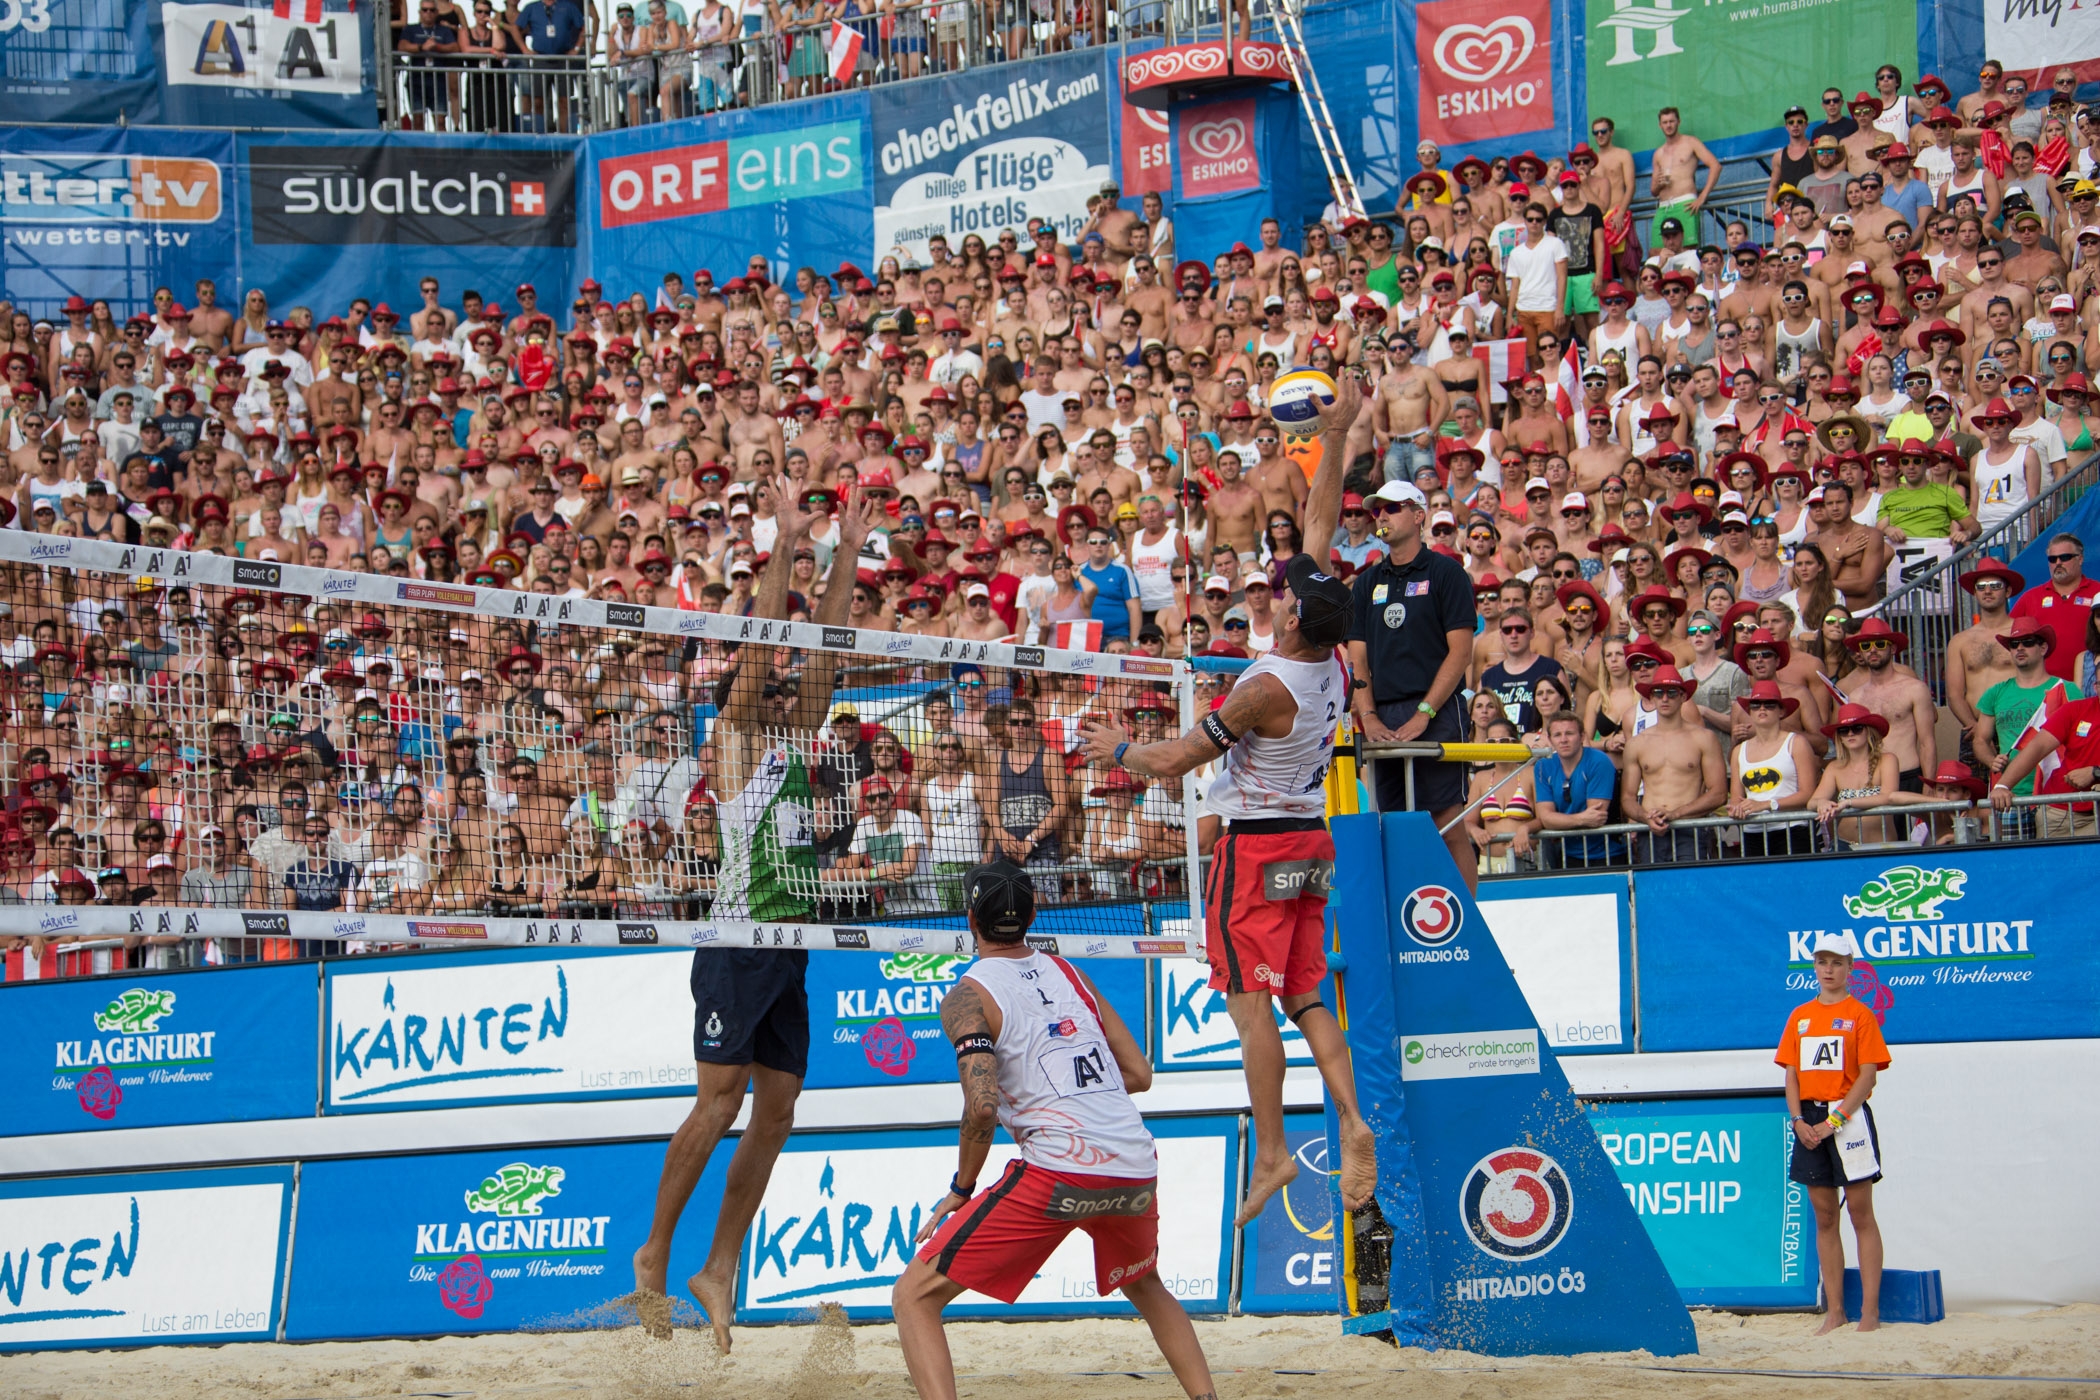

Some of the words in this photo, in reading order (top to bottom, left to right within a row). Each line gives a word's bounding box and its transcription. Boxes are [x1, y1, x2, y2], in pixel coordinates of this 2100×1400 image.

[1437, 81, 1536, 120] ESKIMO
[881, 72, 1100, 176] checkfelix.com
[609, 156, 720, 213] ORF
[735, 135, 852, 193] eins
[924, 176, 967, 201] billige
[974, 150, 1054, 193] Flüge
[1191, 157, 1249, 181] ESKIMO
[0, 171, 209, 207] tter.tv
[283, 171, 506, 216] swatch
[950, 196, 1027, 235] Hotels
[237, 566, 266, 581] smart
[608, 608, 633, 622] smart
[825, 631, 845, 644] smart
[1017, 650, 1036, 663] smart
[1320, 676, 1331, 694] AUT
[1326, 701, 1337, 723] 2
[247, 917, 277, 930] smart
[622, 928, 646, 940] smart
[837, 932, 858, 943] smart
[1028, 940, 1049, 950] smart
[1399, 950, 1453, 964] HITRADIO
[1454, 946, 1470, 961] Ö3
[1785, 971, 1818, 991] Die
[1888, 972, 1926, 987] vom
[1932, 965, 2034, 985] Wörthersee
[836, 984, 955, 1018] KLAGEN
[1036, 987, 1054, 1006] 1
[833, 1027, 861, 1044] Die
[912, 1028, 941, 1040] vom
[1556, 1020, 1618, 1043] Leben
[56, 1031, 215, 1067] KLAGENFURT
[1425, 1040, 1535, 1060] checkrobin.com
[1812, 1039, 1839, 1066] A1
[1073, 1047, 1105, 1089] A1
[1468, 1057, 1498, 1070] private
[1498, 1056, 1536, 1069] bringen's
[52, 1074, 75, 1091] Die
[120, 1075, 144, 1087] vom
[148, 1068, 214, 1084] Wörthersee
[580, 1068, 614, 1089] Lust
[619, 1071, 643, 1086] am
[649, 1064, 697, 1085] Leben
[1601, 1130, 1741, 1166] ROPEAN
[1845, 1138, 1866, 1151] Zewa
[415, 1216, 611, 1254] KLAGENFURT
[1784, 1180, 1802, 1282] VOLLEYBALL
[408, 1264, 437, 1283] Die
[490, 1267, 521, 1279] vom
[525, 1258, 605, 1278] Wörthersee
[1062, 1276, 1096, 1298] Lus
[1456, 1273, 1555, 1301] HITRADIO
[1557, 1267, 1586, 1293] Ö3
[142, 1312, 177, 1333] Lust
[182, 1313, 208, 1331] am
[215, 1307, 266, 1330] Leben
